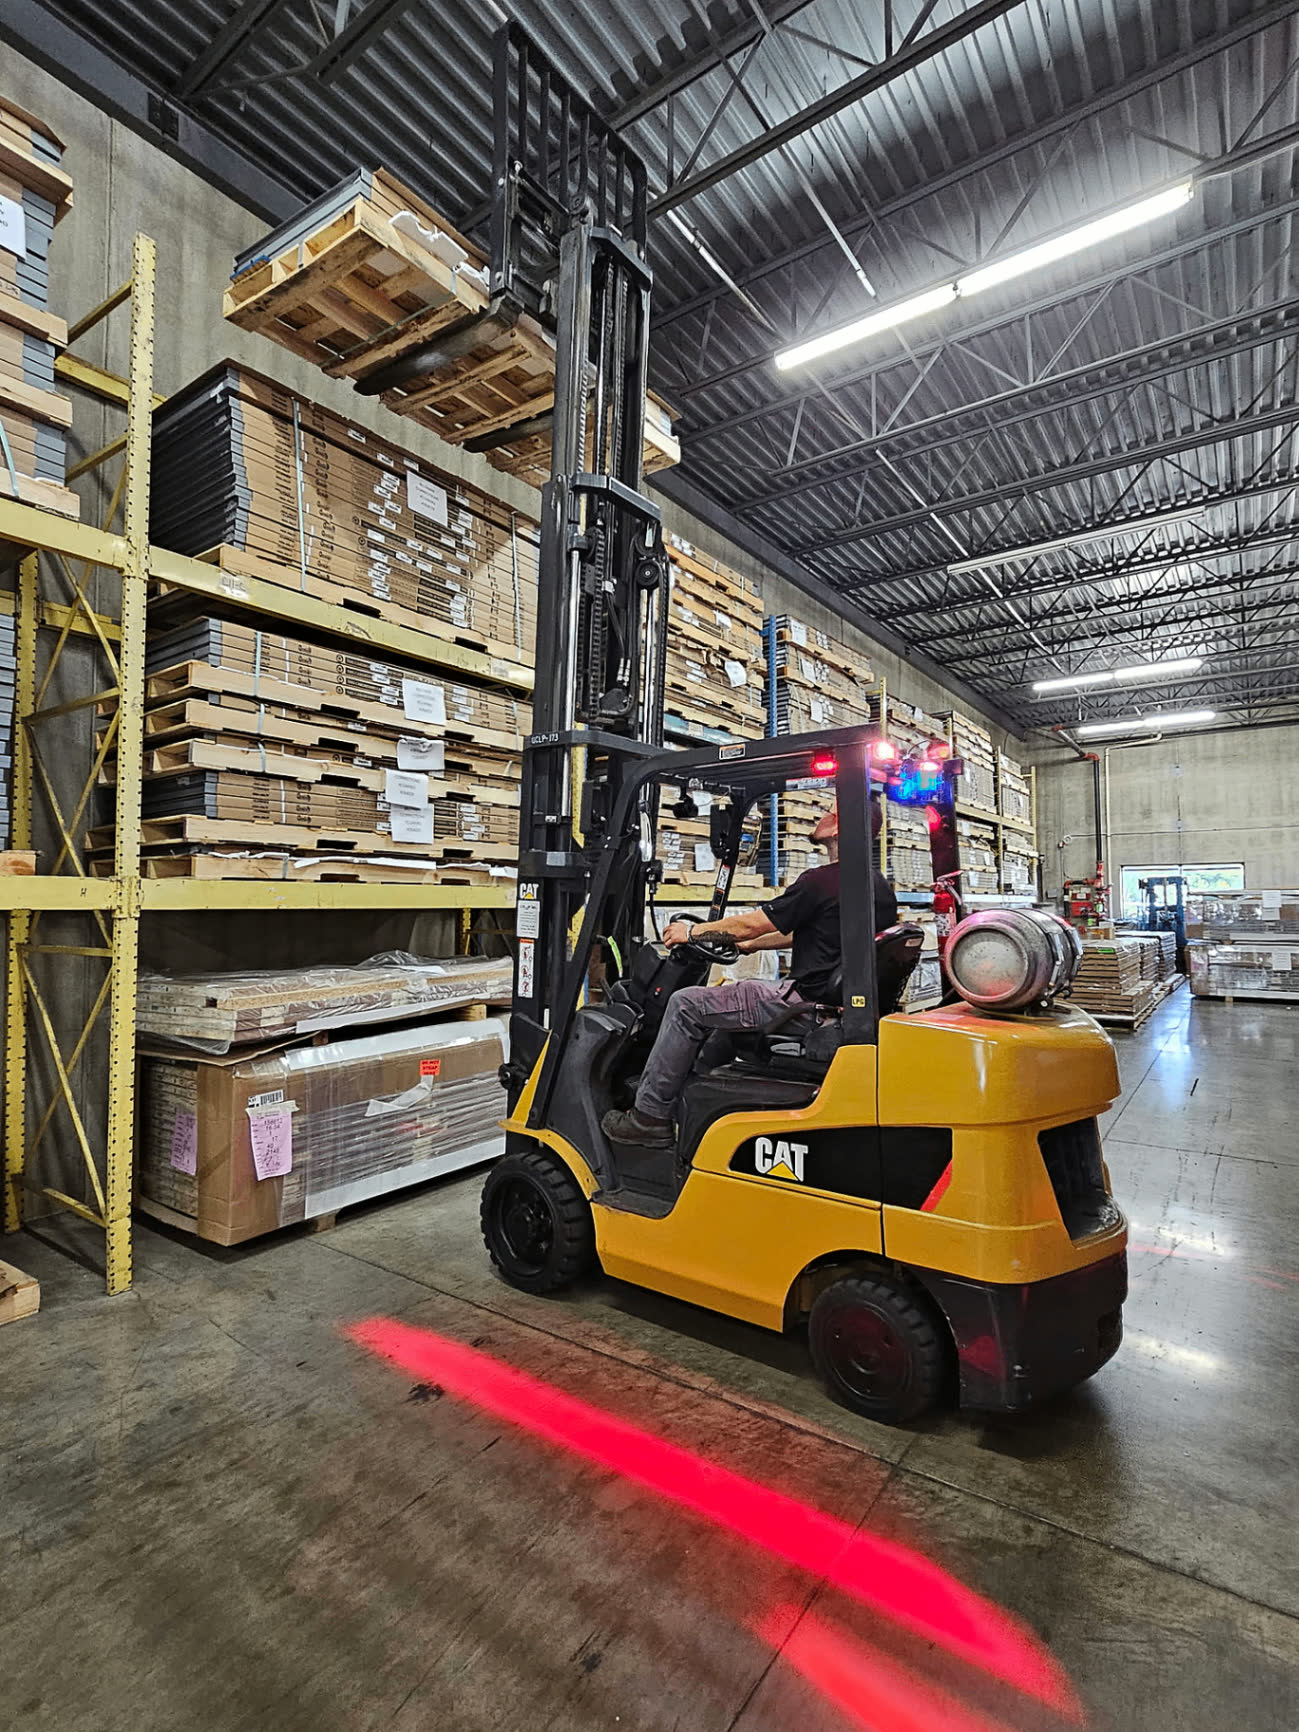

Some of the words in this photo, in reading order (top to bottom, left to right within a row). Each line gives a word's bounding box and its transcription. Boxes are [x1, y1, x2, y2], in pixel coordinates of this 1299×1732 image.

[519, 883, 539, 899] CAT
[852, 997, 864, 1005] LPG
[755, 1137, 808, 1182] CAT
